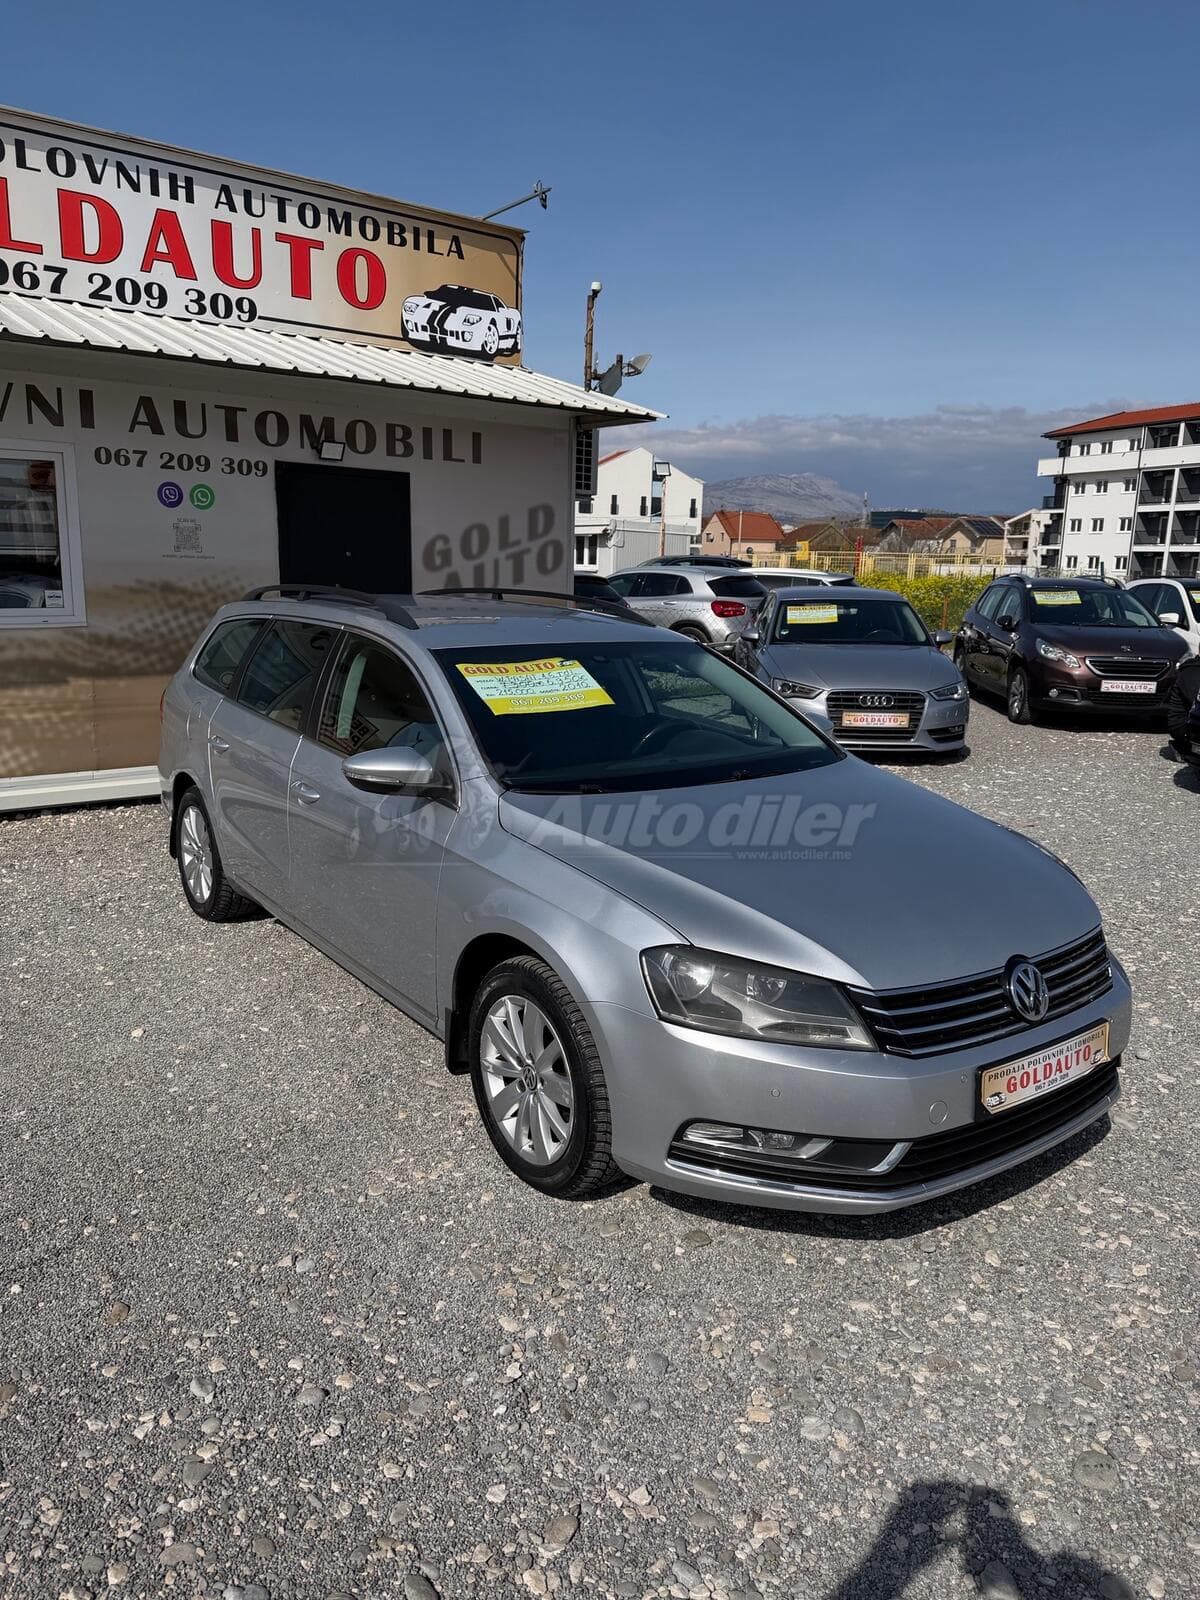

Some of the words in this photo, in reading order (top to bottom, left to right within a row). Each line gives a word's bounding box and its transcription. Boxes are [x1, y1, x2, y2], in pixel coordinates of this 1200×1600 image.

[0, 138, 195, 204] LOVNIH
[214, 184, 465, 260] AUTOMOBILA
[88, 273, 168, 309] 209
[184, 288, 258, 323] 309
[128, 395, 482, 464] AUTOMOBILI
[94, 446, 147, 468] 067
[159, 452, 211, 472] 209
[221, 457, 268, 478] 309
[422, 503, 555, 573] GOLD
[463, 666, 509, 674] GOLD
[514, 661, 555, 674] AUTO
[987, 1062, 1026, 1083] PRODAJA
[1027, 1048, 1065, 1068] POLOVNIH
[1006, 1045, 1093, 1094] GOLDAUTO
